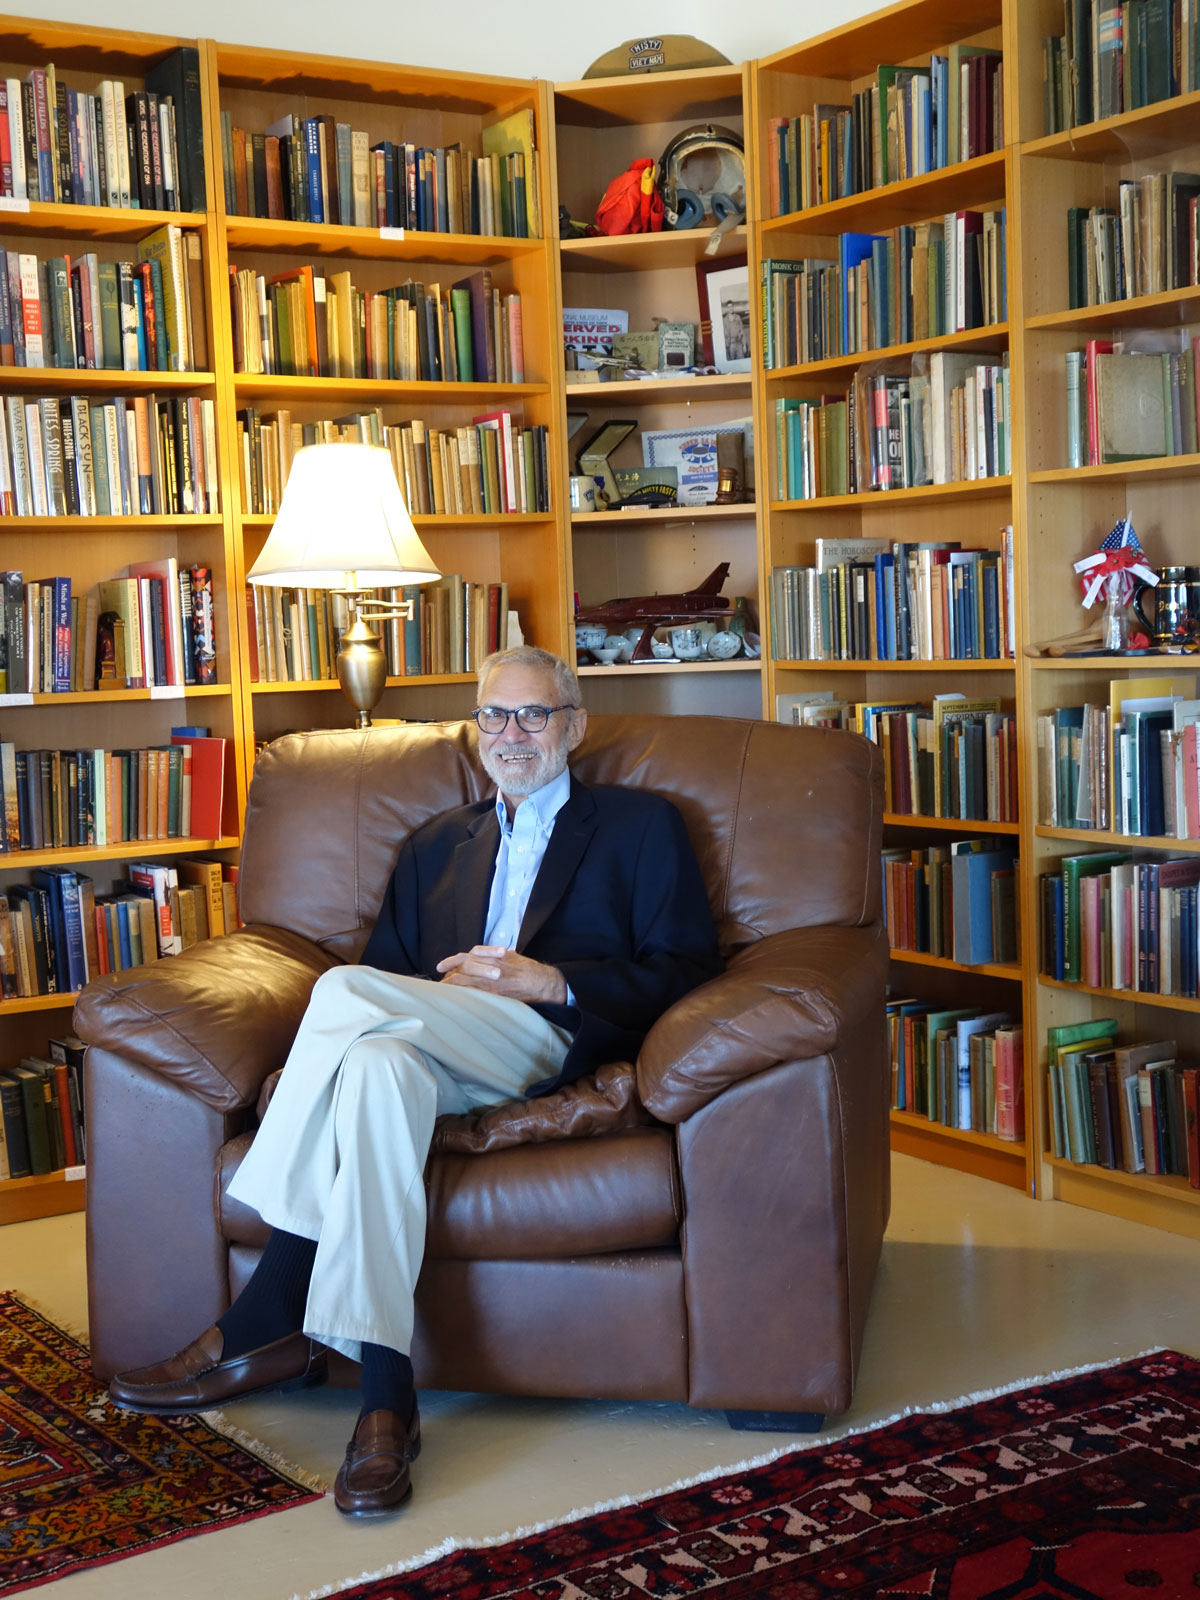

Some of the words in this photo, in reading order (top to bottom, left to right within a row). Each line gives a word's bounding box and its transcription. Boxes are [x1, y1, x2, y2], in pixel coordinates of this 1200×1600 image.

[634, 40, 660, 52] MISTY
[37, 74, 45, 100] POPPY
[57, 86, 66, 110] THE
[38, 102, 47, 129] FIELDS
[58, 113, 69, 155] SOMME
[152, 132, 160, 166] GENERATION
[144, 165, 150, 174] OF
[772, 262, 792, 271] MONK
[13, 406, 22, 434] WAR
[43, 403, 59, 430] RITES
[62, 419, 73, 435] RITES
[77, 405, 89, 441] BLACK
[64, 439, 74, 460] SPRING
[93, 425, 103, 456] Georgian
[680, 438, 698, 451] SUPER
[15, 436, 26, 479] ARTISTS
[47, 438, 62, 473] SPRING
[80, 443, 92, 473] SUN
[688, 465, 715, 473] SOCIETY
[642, 486, 658, 494] MISTY
[659, 486, 672, 496] FAST
[841, 546, 884, 555] HOROSCOPE
